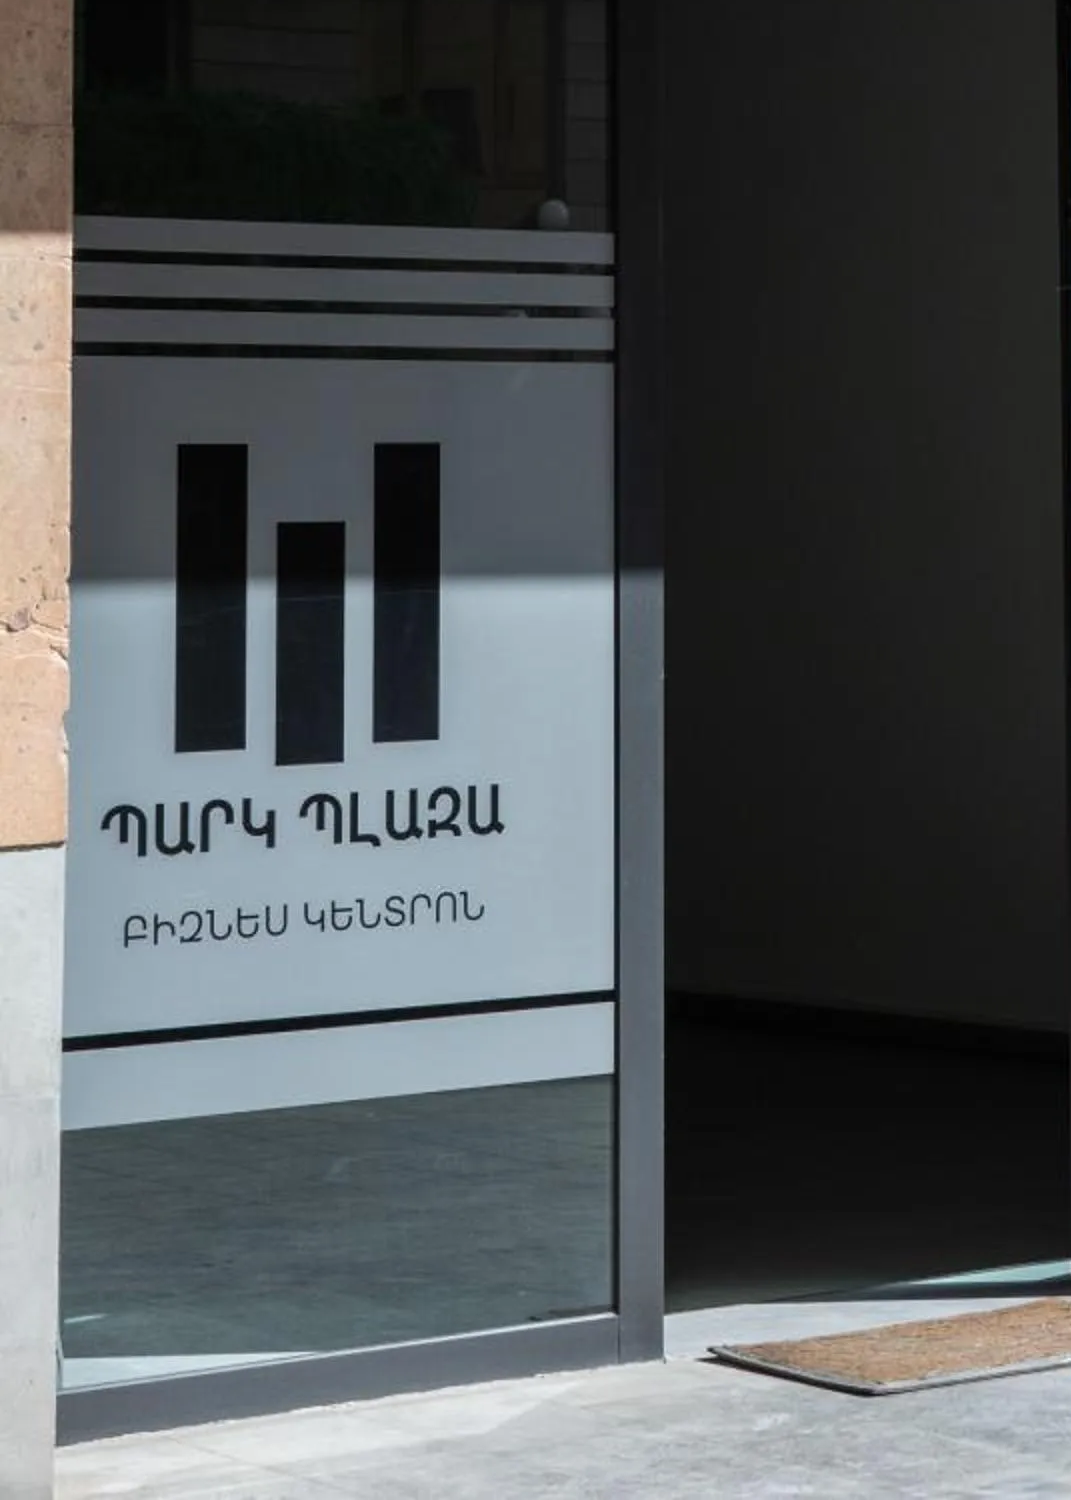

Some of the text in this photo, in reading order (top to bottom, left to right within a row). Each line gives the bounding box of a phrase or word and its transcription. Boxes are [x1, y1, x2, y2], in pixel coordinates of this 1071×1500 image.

[101, 784, 505, 857] ՊԱՐԿ ՊԼԱԶԱ
[123, 891, 485, 948] ԲԻԶՆԵՍ ԿԵՆՏՐՈՆ
